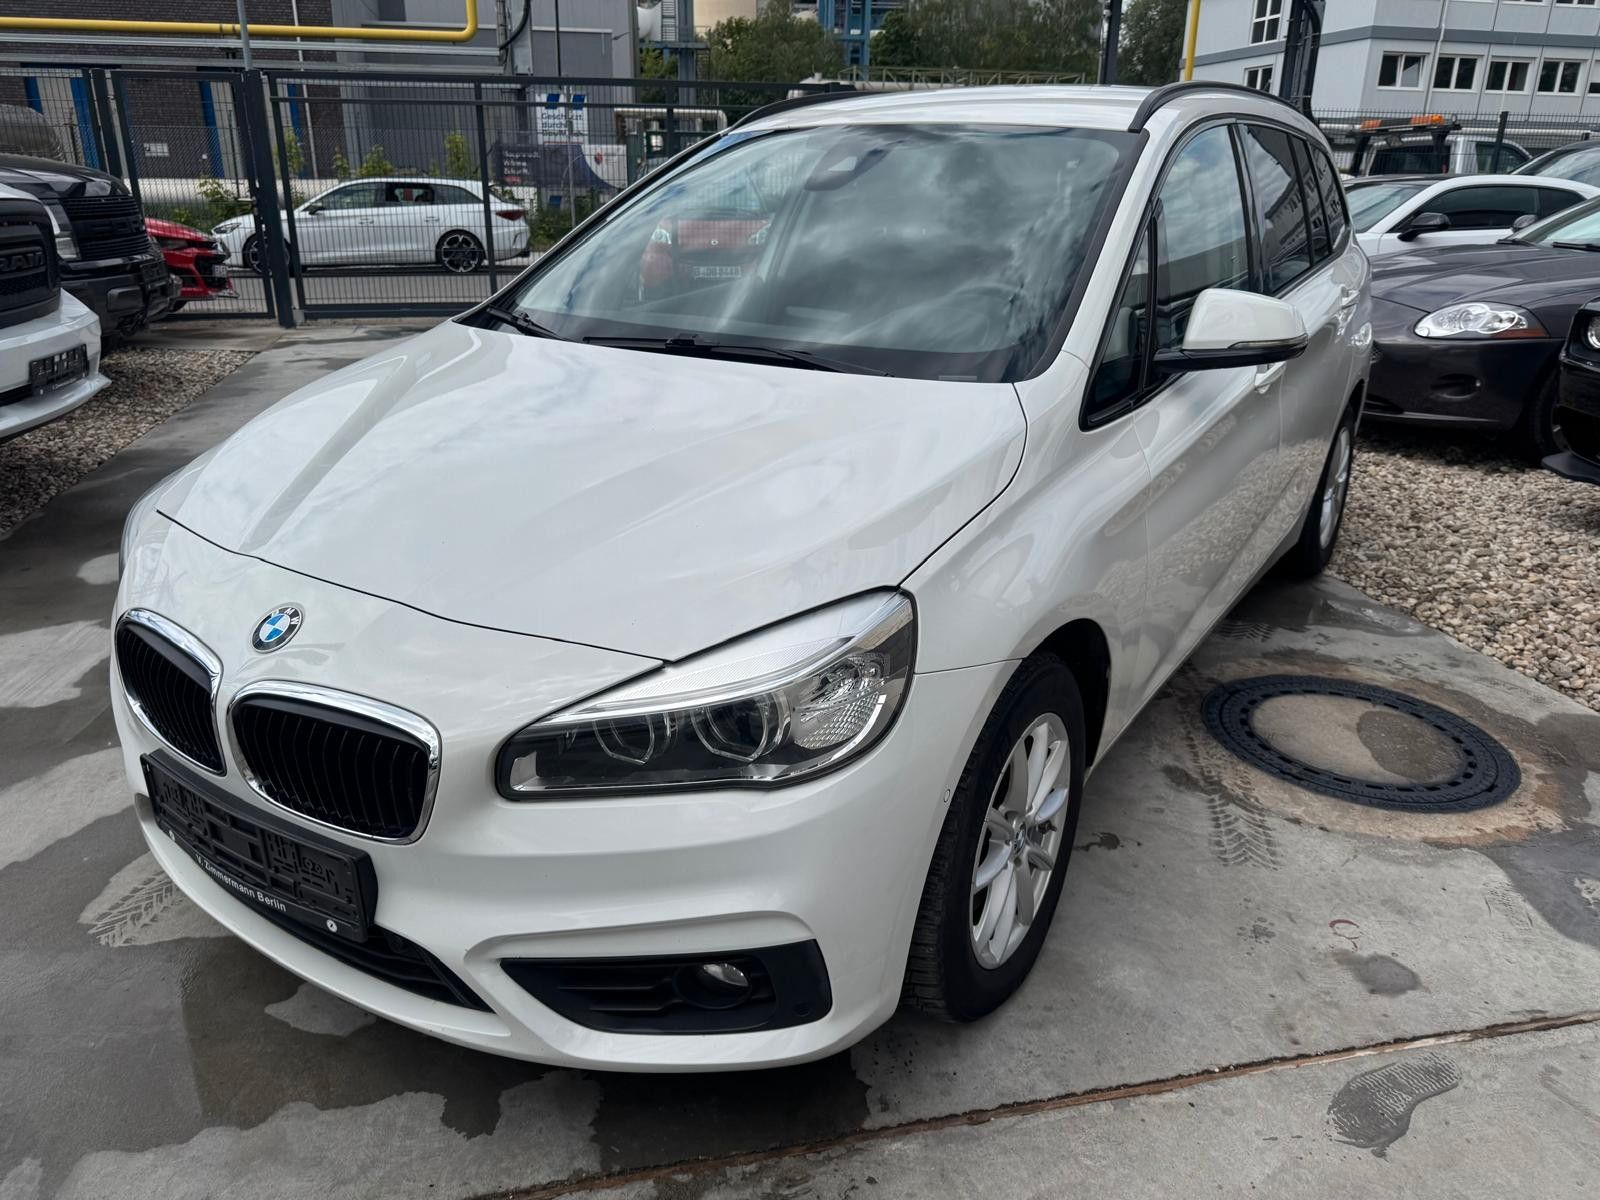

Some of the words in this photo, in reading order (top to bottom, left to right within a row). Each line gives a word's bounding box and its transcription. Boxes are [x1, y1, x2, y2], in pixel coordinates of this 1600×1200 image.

[541, 121, 568, 129] durch
[204, 860, 256, 899] Zimmermann
[257, 891, 287, 912] Berlin
